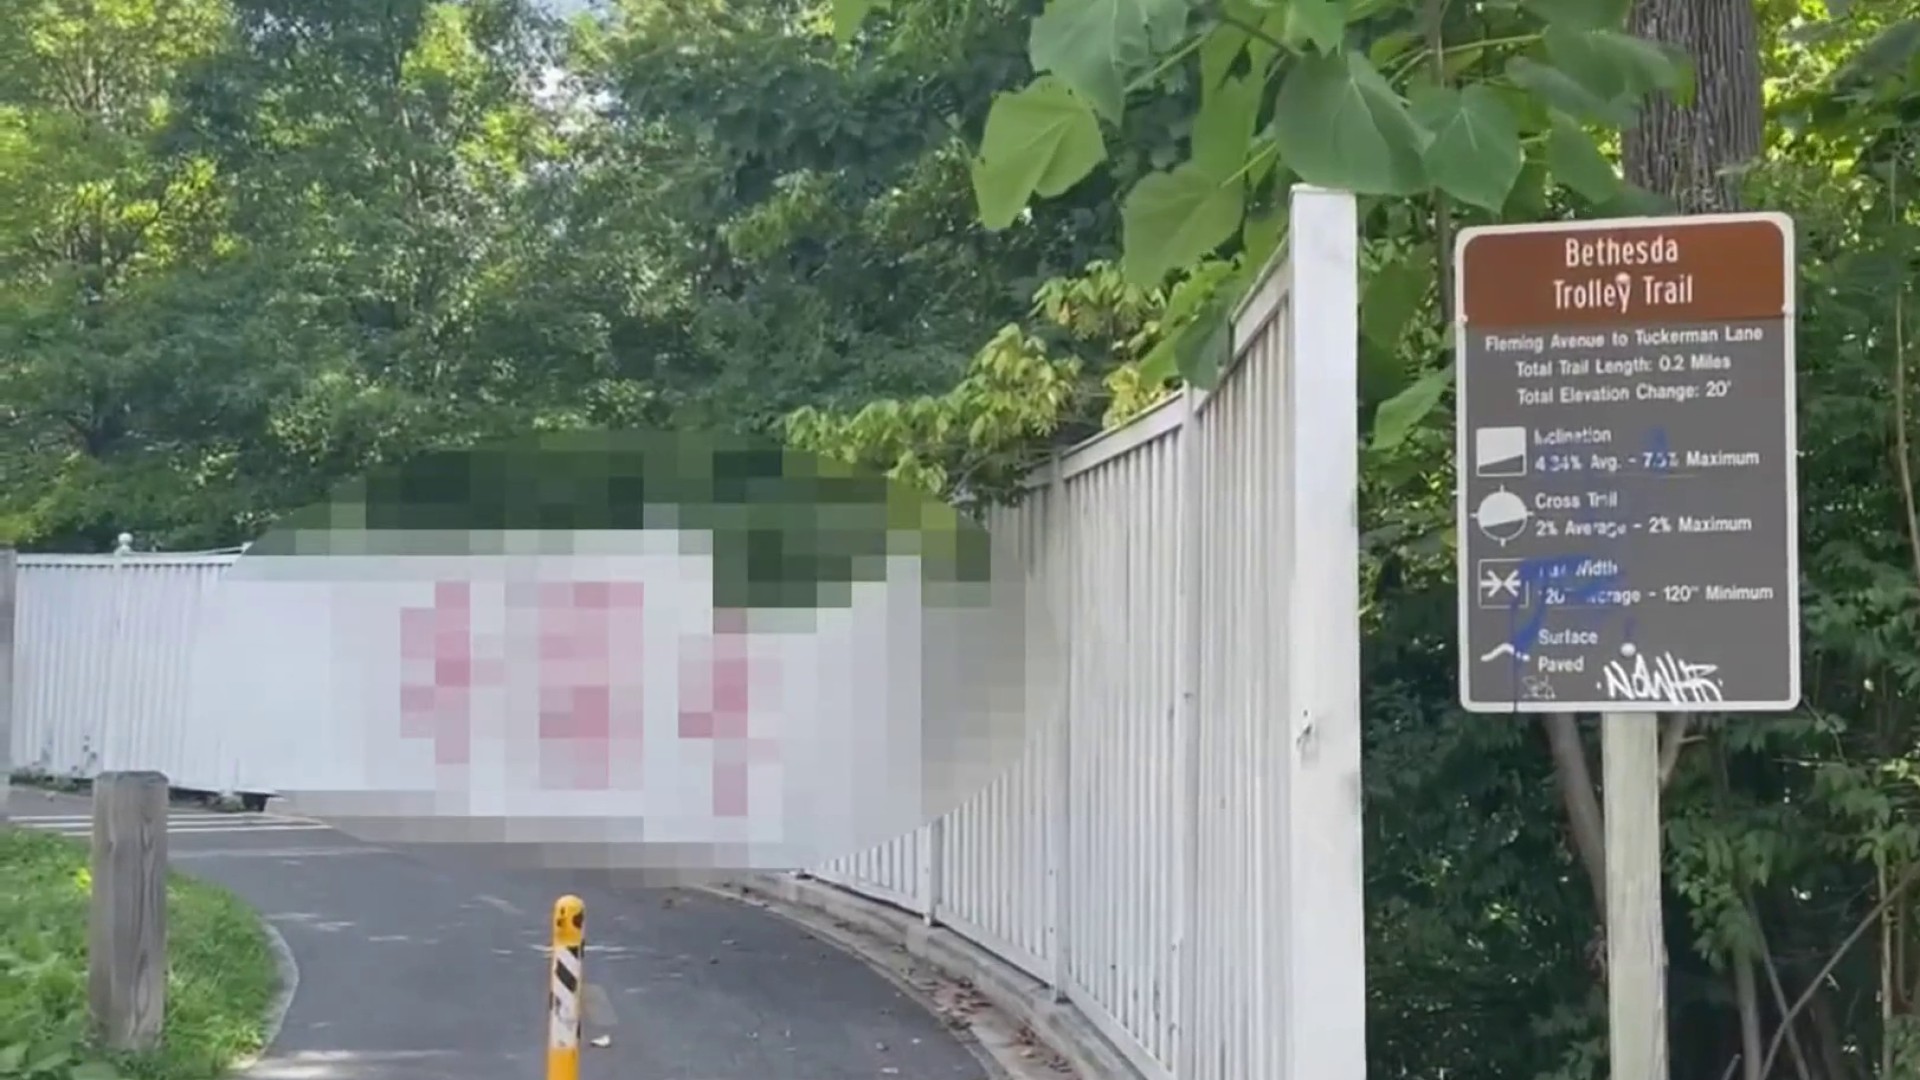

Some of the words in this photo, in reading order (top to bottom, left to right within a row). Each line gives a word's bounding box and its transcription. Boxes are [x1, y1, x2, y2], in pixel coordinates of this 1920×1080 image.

[1566, 235, 1678, 267] Bethesda
[1553, 274, 1632, 314] Trolley
[1643, 275, 1692, 304] Trail
[1485, 335, 1544, 353] Fleming
[1551, 334, 1604, 348] Avenue
[1612, 332, 1628, 347] to
[1635, 328, 1718, 345] Tuckerman
[1725, 326, 1763, 341] Lane
[1516, 361, 1552, 377] Total
[1559, 360, 1589, 375] Trail
[1596, 357, 1652, 376] Length:
[1659, 354, 1684, 371] 0.2
[1691, 354, 1731, 369] Miles
[1517, 387, 1553, 405] Total
[1560, 387, 1629, 403] Elevation
[1636, 383, 1699, 402] Change:
[1686, 451, 1759, 466] Maximum
[1535, 493, 1580, 509] Cross
[1536, 520, 1558, 536] 2%
[1649, 517, 1671, 533] 2%
[1679, 516, 1752, 532] Maximum
[1706, 585, 1773, 600] Minimum
[1539, 629, 1598, 645] Surface
[1538, 656, 1584, 672] Paved
